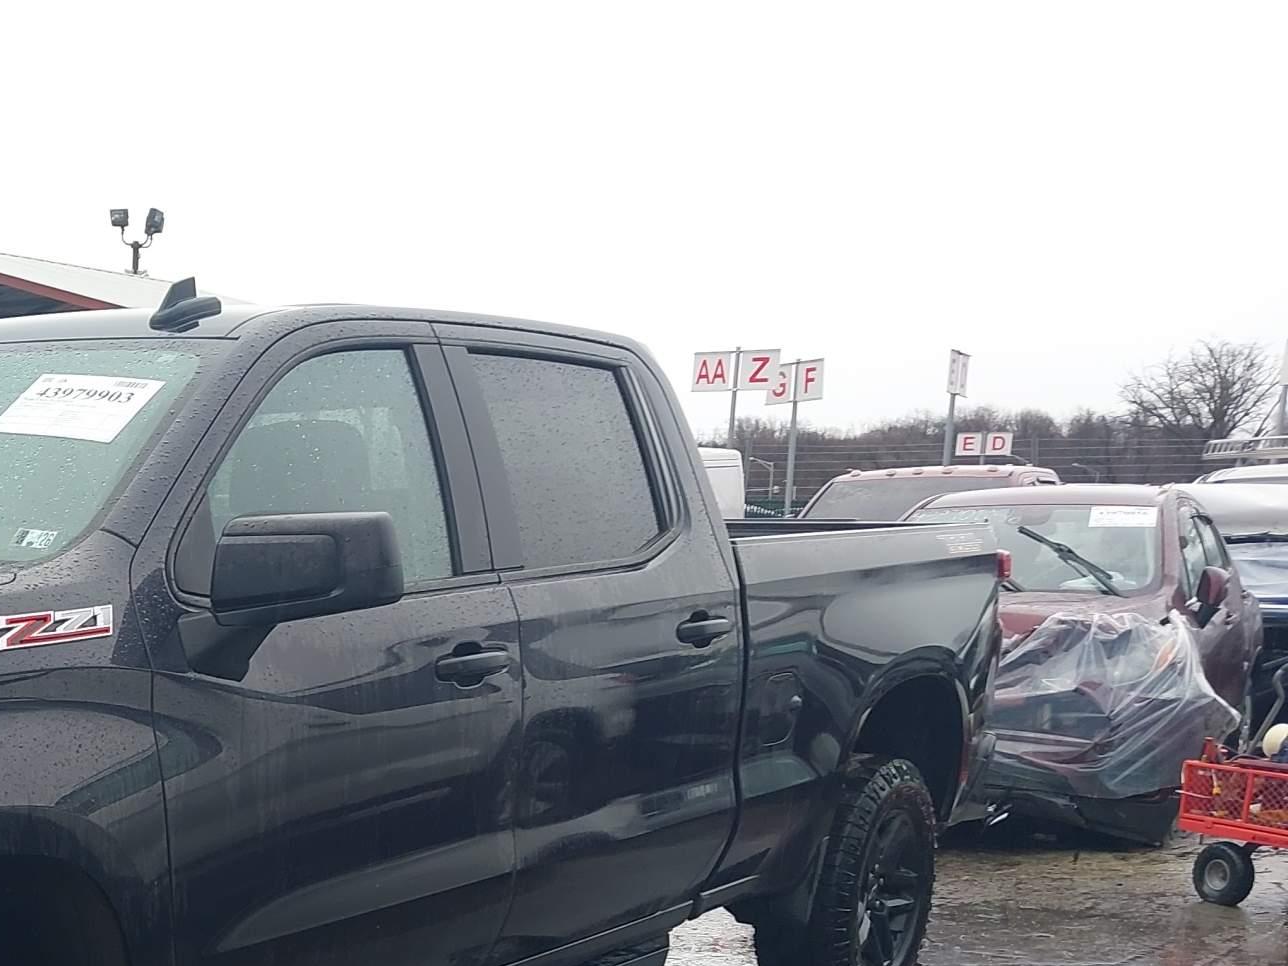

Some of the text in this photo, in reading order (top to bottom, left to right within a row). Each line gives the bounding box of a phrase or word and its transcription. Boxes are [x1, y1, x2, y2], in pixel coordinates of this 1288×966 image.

[695, 358, 727, 385] AA
[748, 356, 771, 383] Z
[803, 366, 818, 394] F
[35, 386, 136, 404] 43979903
[962, 436, 977, 452] E
[991, 435, 1006, 451] D
